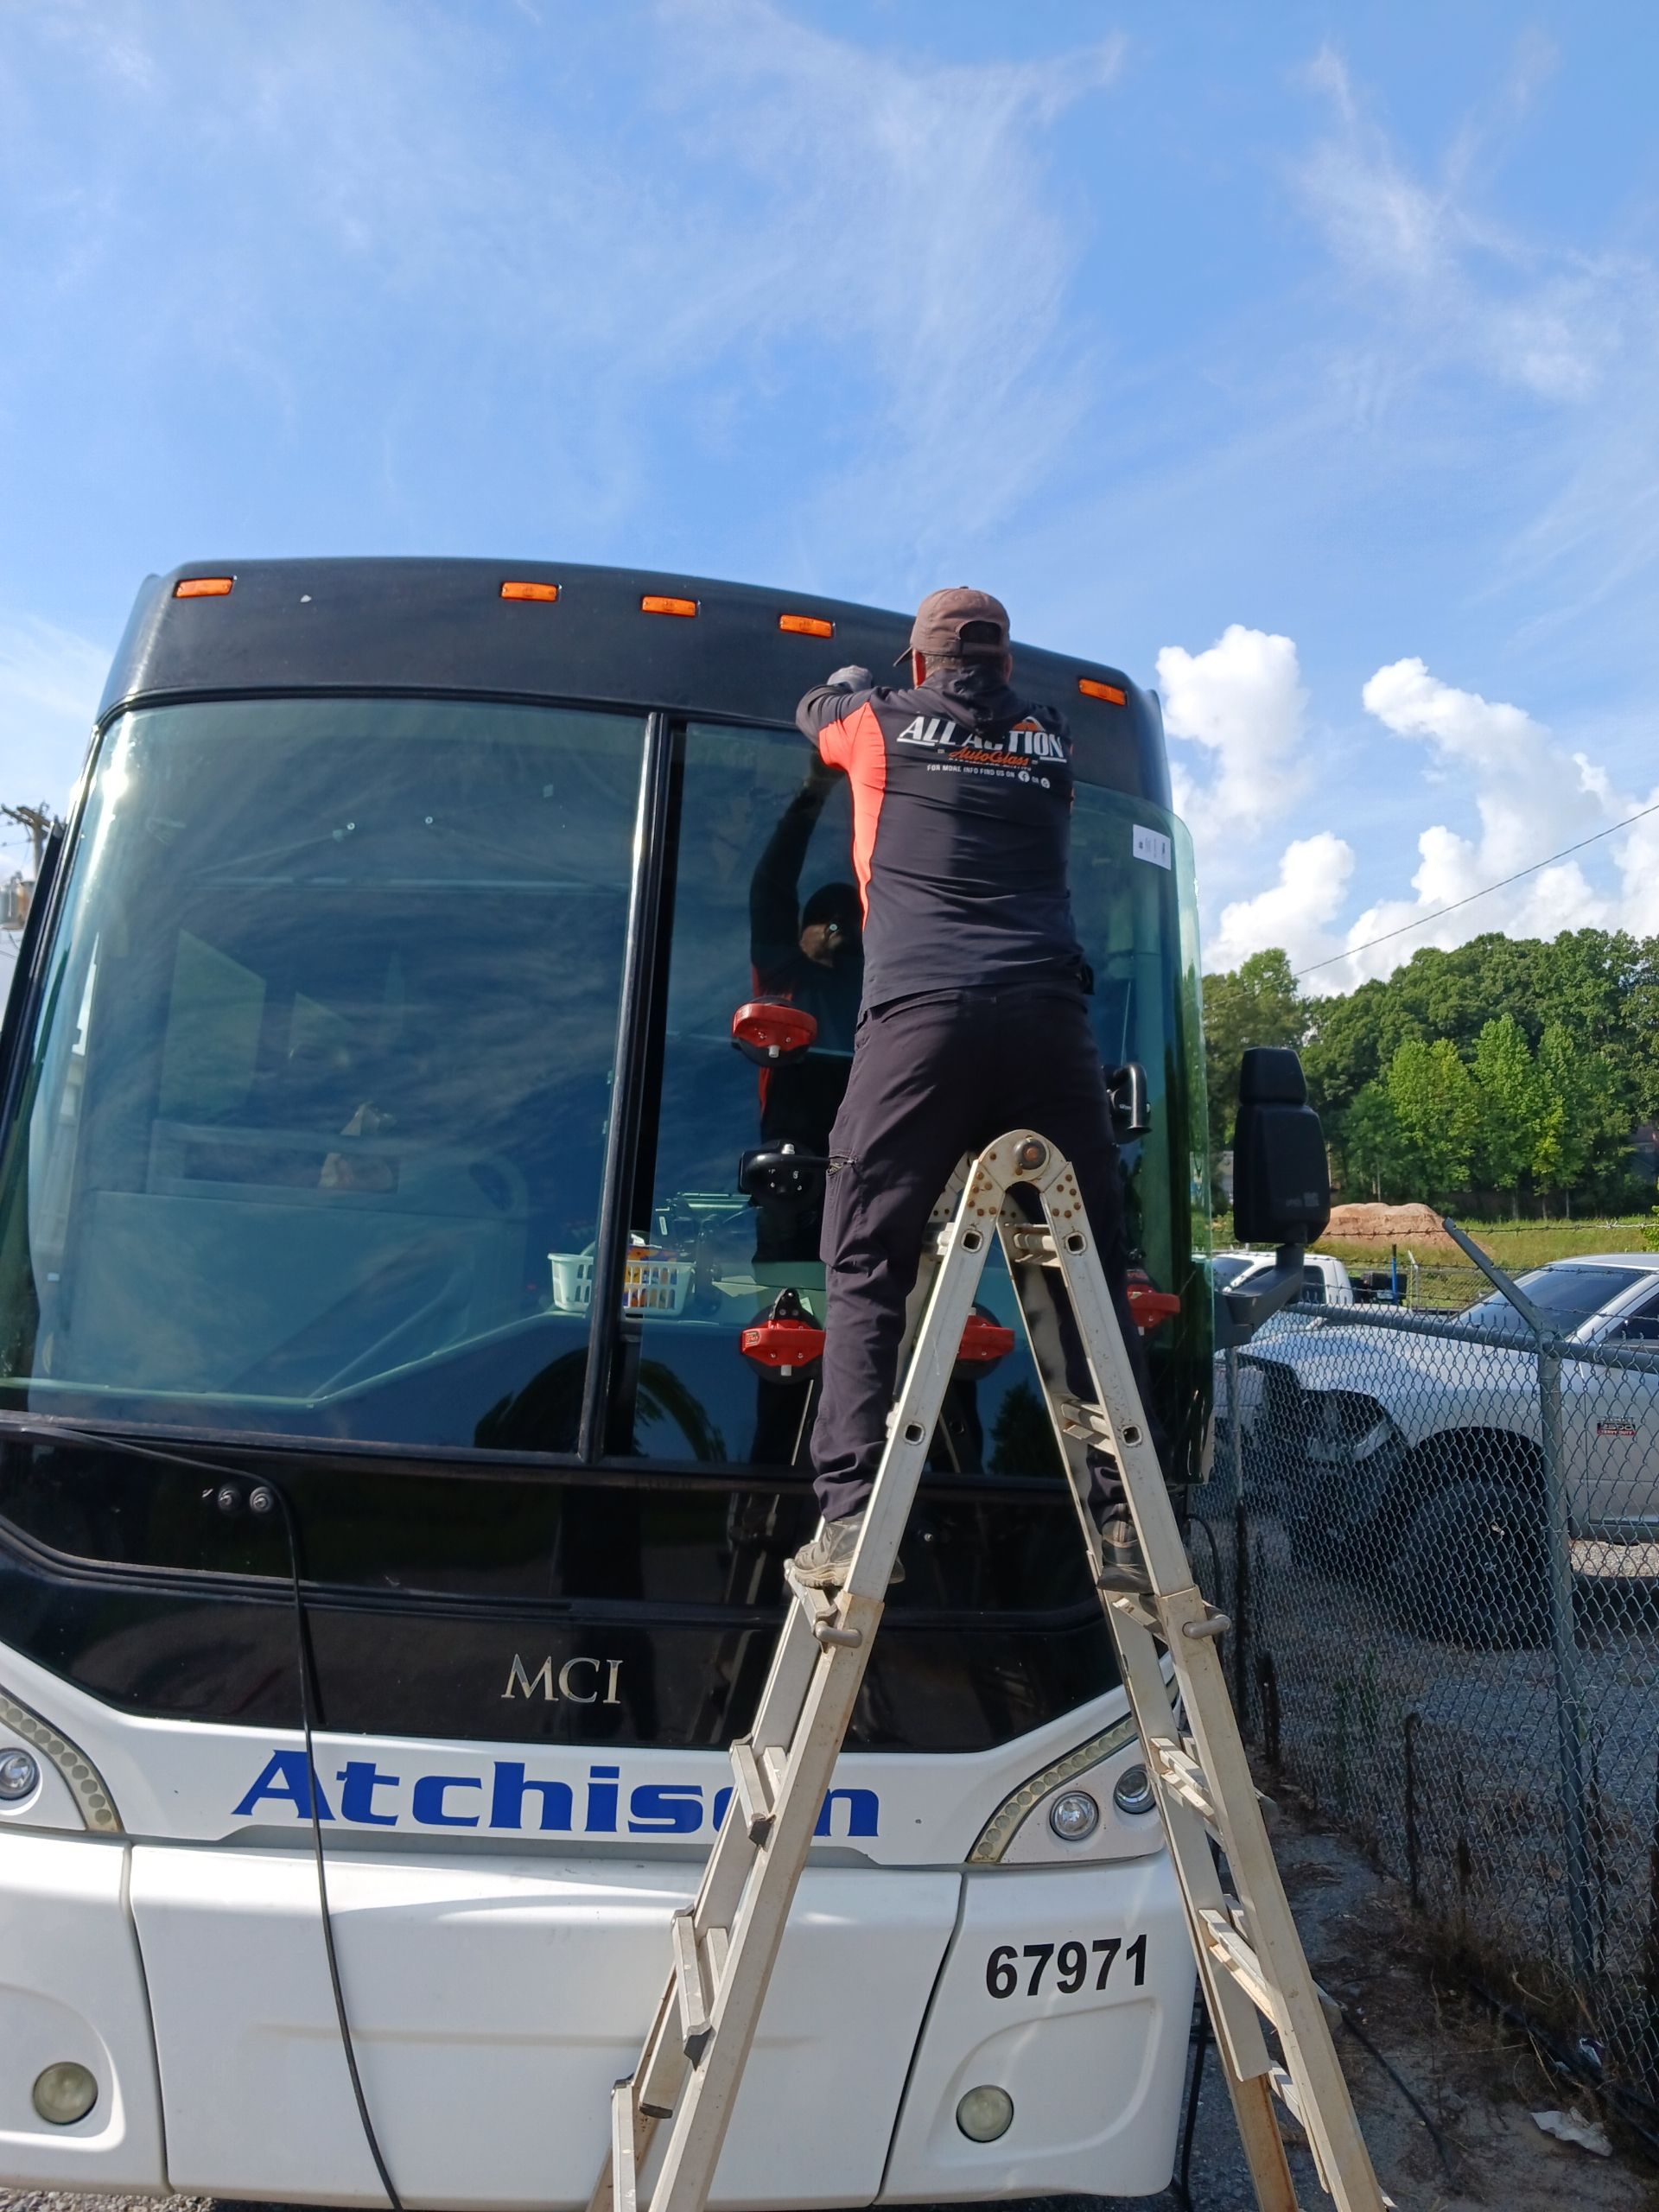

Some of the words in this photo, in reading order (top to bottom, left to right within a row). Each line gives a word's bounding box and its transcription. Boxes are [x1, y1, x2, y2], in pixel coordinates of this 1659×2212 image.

[899, 715, 957, 747] ALL
[949, 746, 1030, 766] AutoGlass
[963, 766, 979, 775] INFO
[979, 767, 995, 776] FIND
[501, 1653, 623, 1704] MCI
[231, 1750, 879, 1837] Atchisn
[986, 1934, 1147, 1999] 67971
